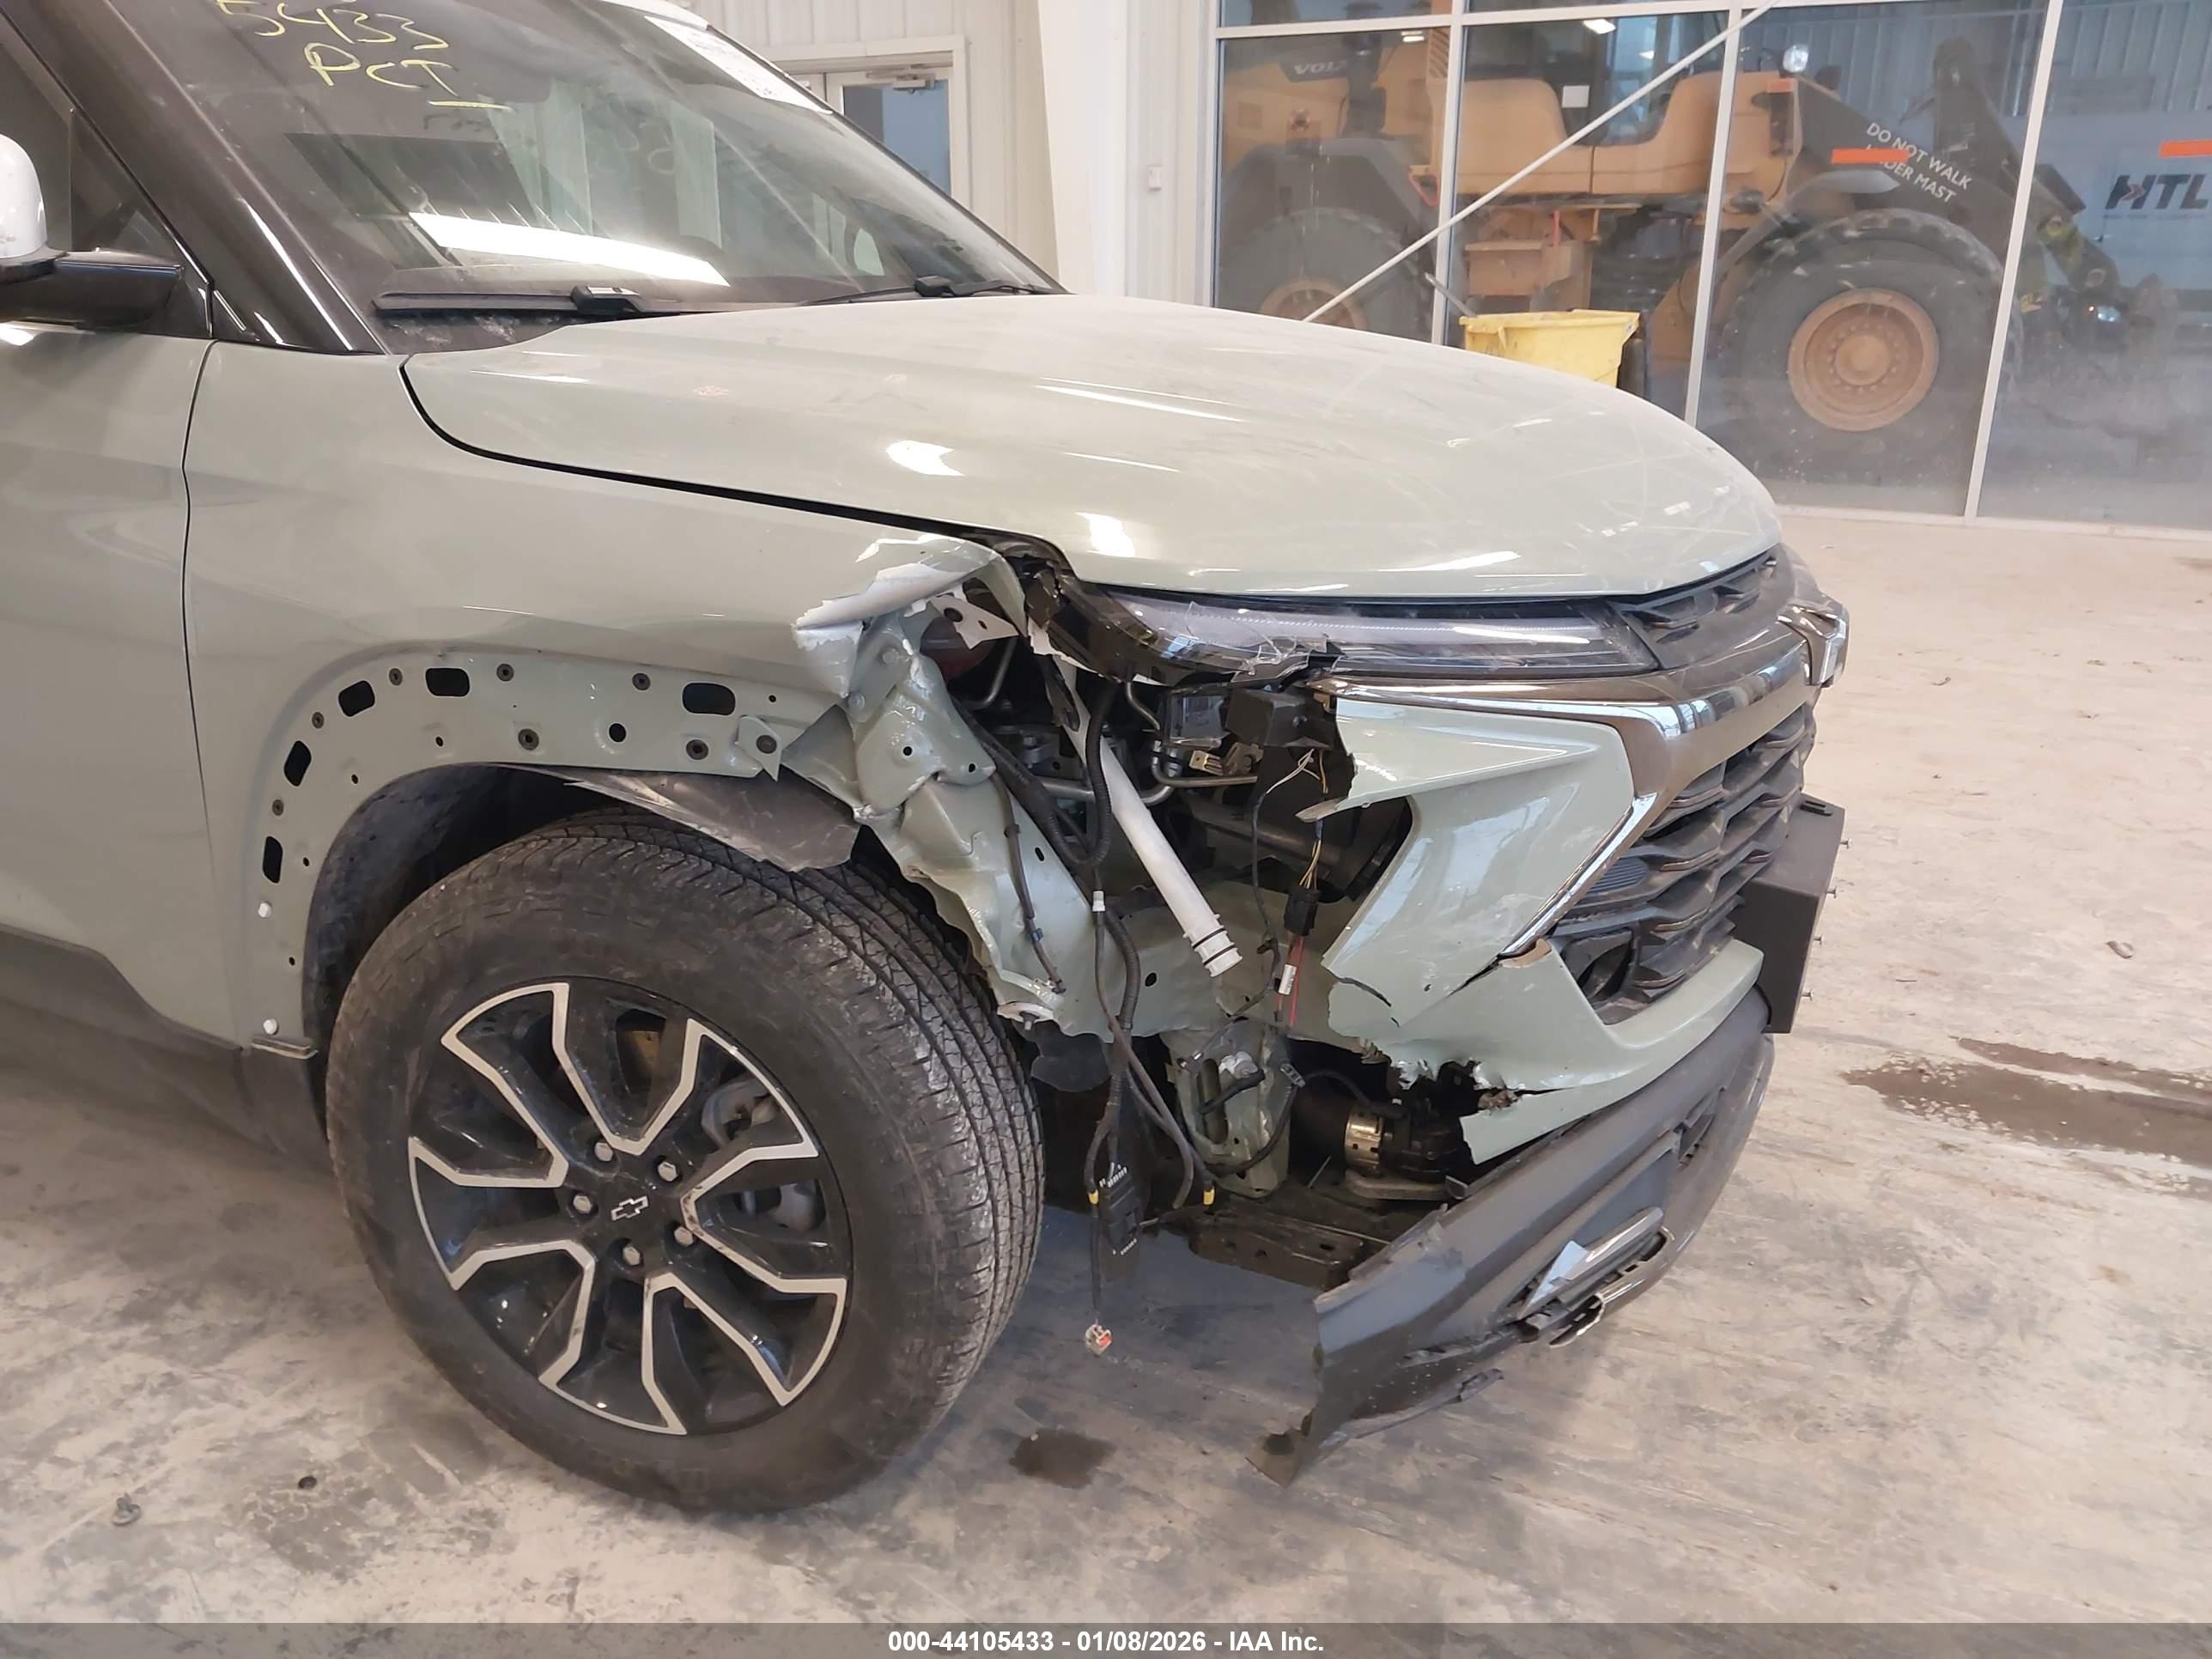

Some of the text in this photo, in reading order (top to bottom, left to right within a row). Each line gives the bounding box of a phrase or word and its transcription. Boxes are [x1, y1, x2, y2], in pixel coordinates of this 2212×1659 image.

[215, 0, 449, 50] 5433
[1293, 62, 1346, 75] VOL
[1866, 123, 1972, 190] DO NOT WALK
[1913, 173, 1957, 203] MAST
[2105, 174, 2209, 210] HTL
